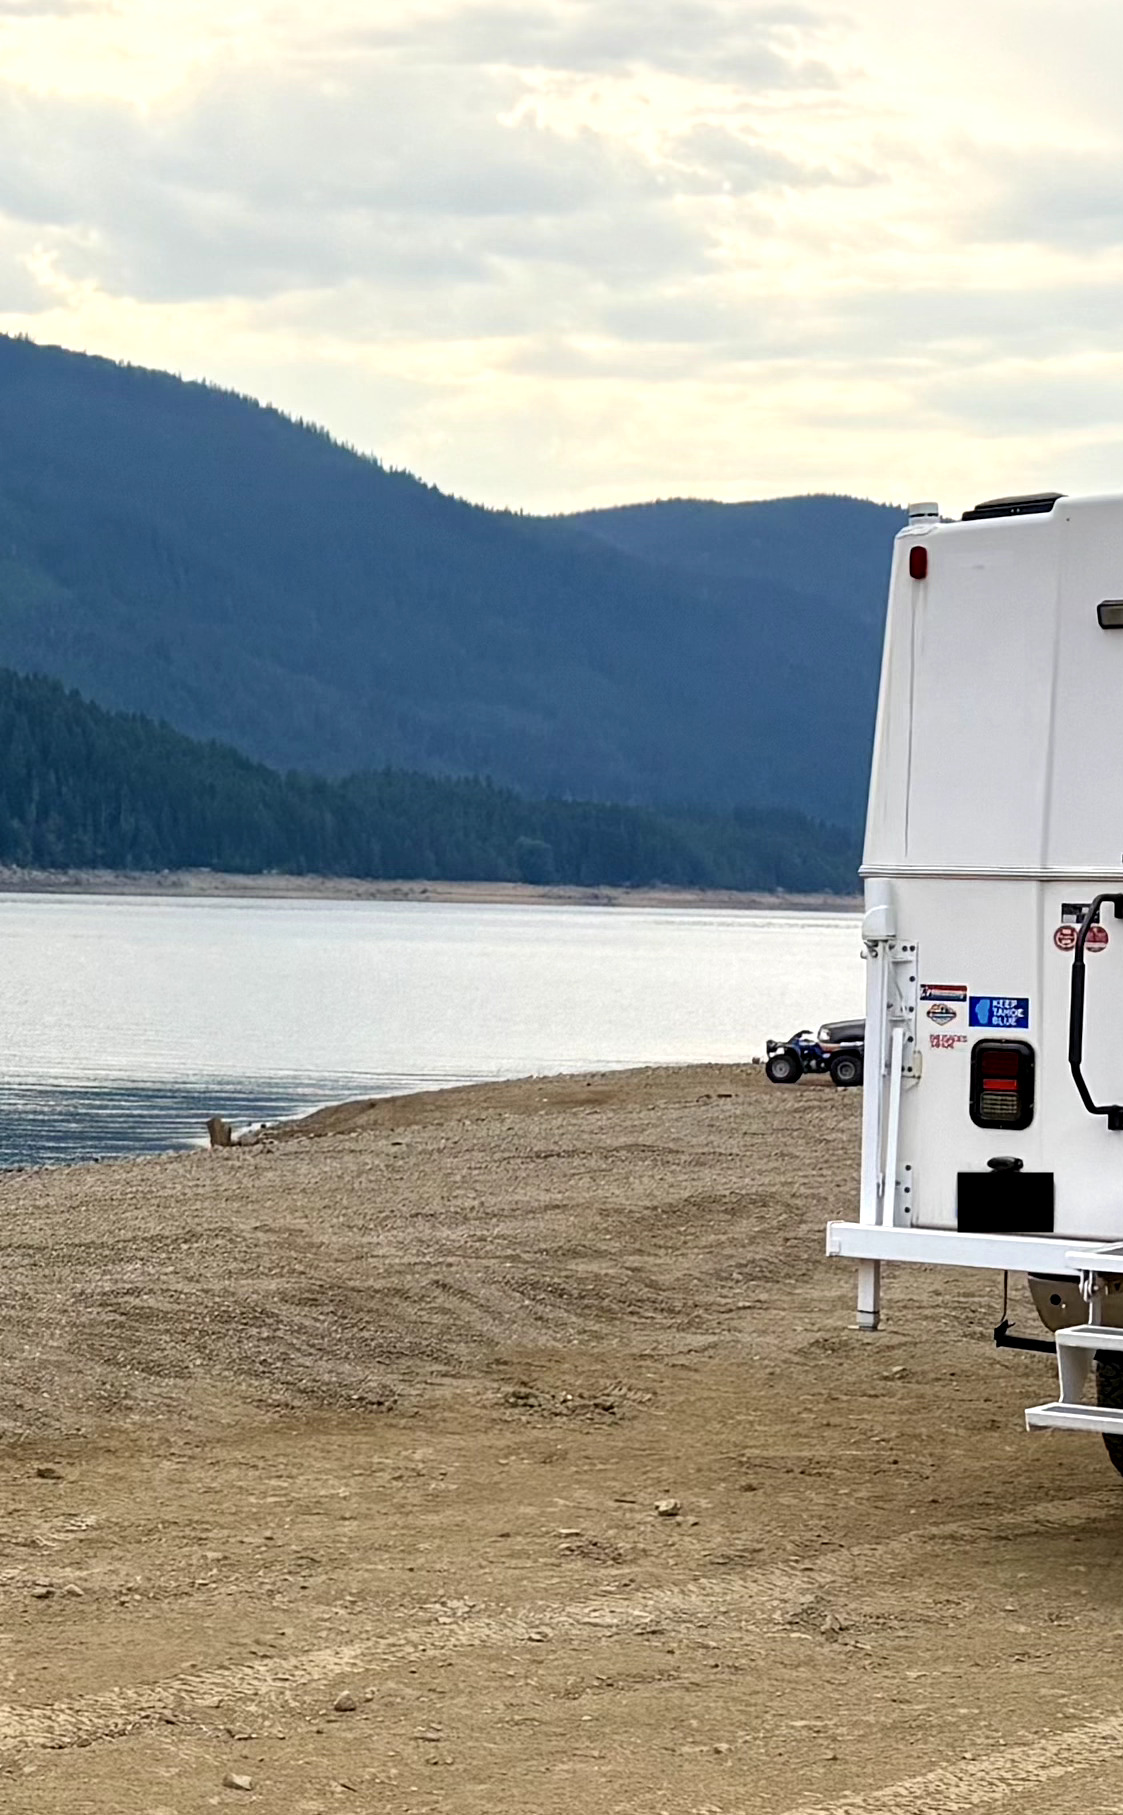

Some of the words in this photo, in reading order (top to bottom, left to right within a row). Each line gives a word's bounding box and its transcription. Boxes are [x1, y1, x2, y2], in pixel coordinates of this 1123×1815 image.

[992, 999, 1018, 1009] KEEP
[992, 1008, 1025, 1018] TAHOE
[991, 1017, 1018, 1026] BLUE
